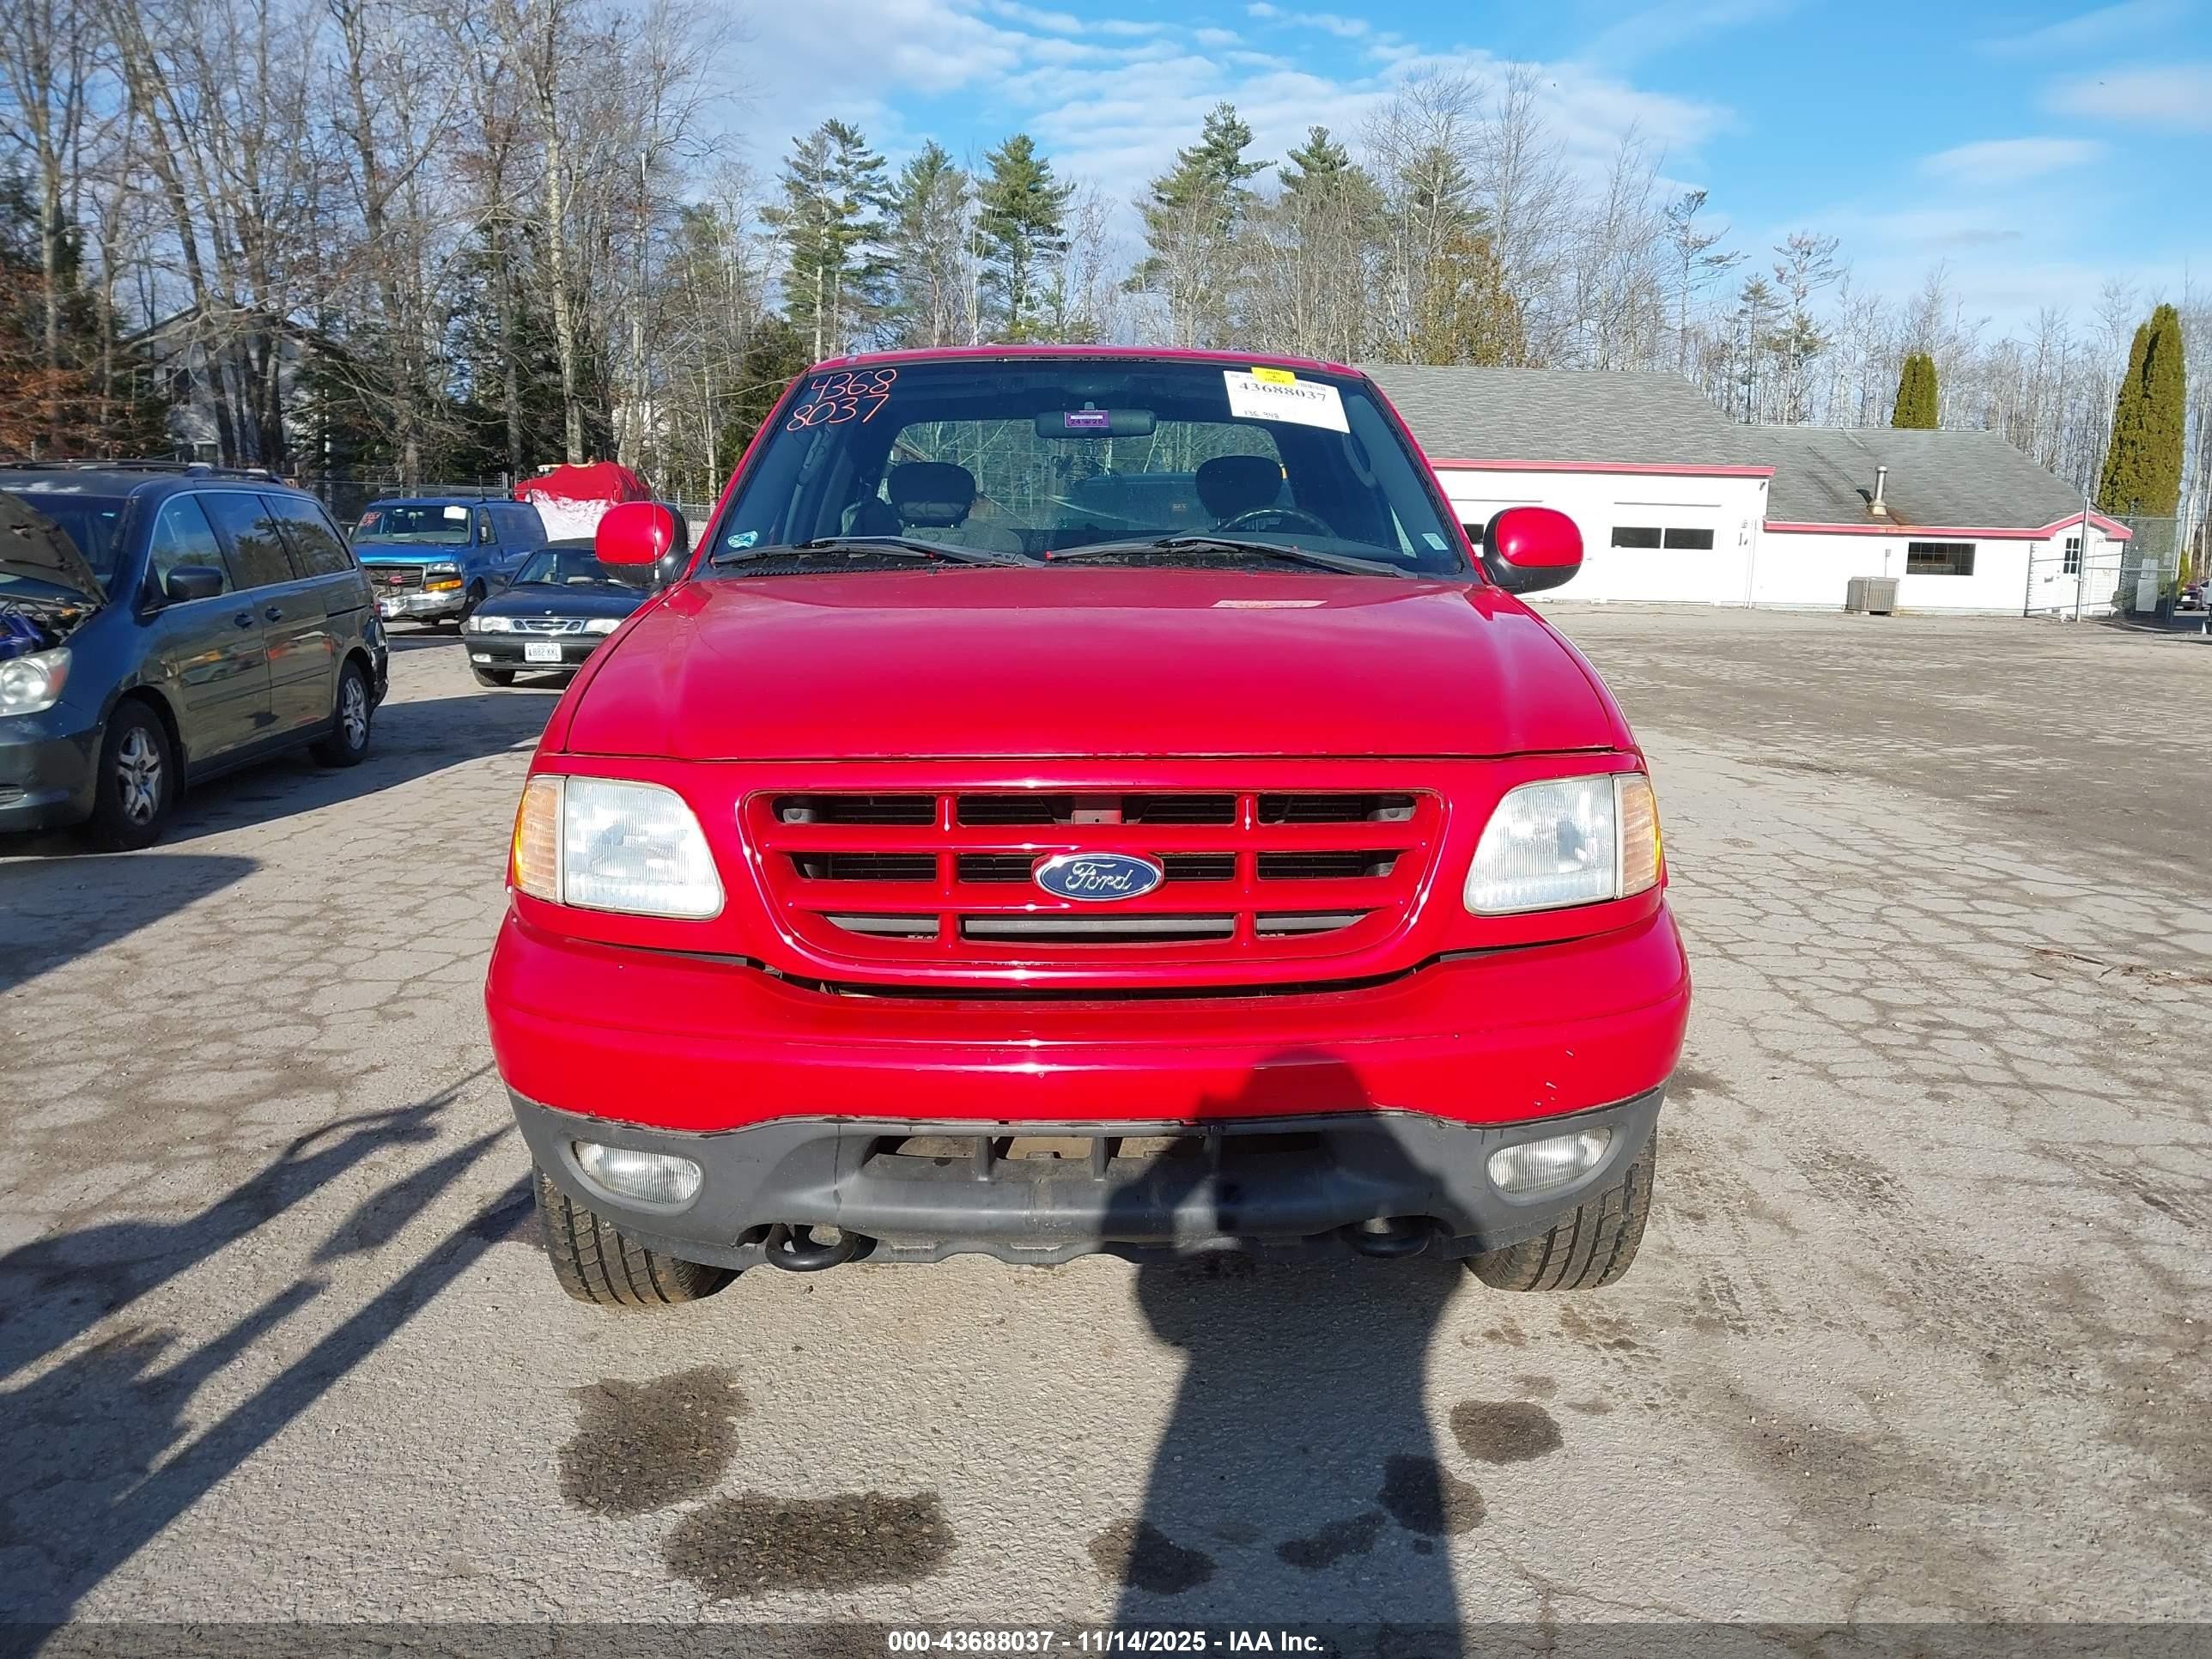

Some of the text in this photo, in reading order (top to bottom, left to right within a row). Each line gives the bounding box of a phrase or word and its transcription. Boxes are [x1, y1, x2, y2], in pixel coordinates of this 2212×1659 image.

[811, 368, 897, 404] 4368
[1239, 382, 1326, 402] 43688037
[786, 393, 890, 431] 8037
[1065, 862, 1134, 890] Ford
